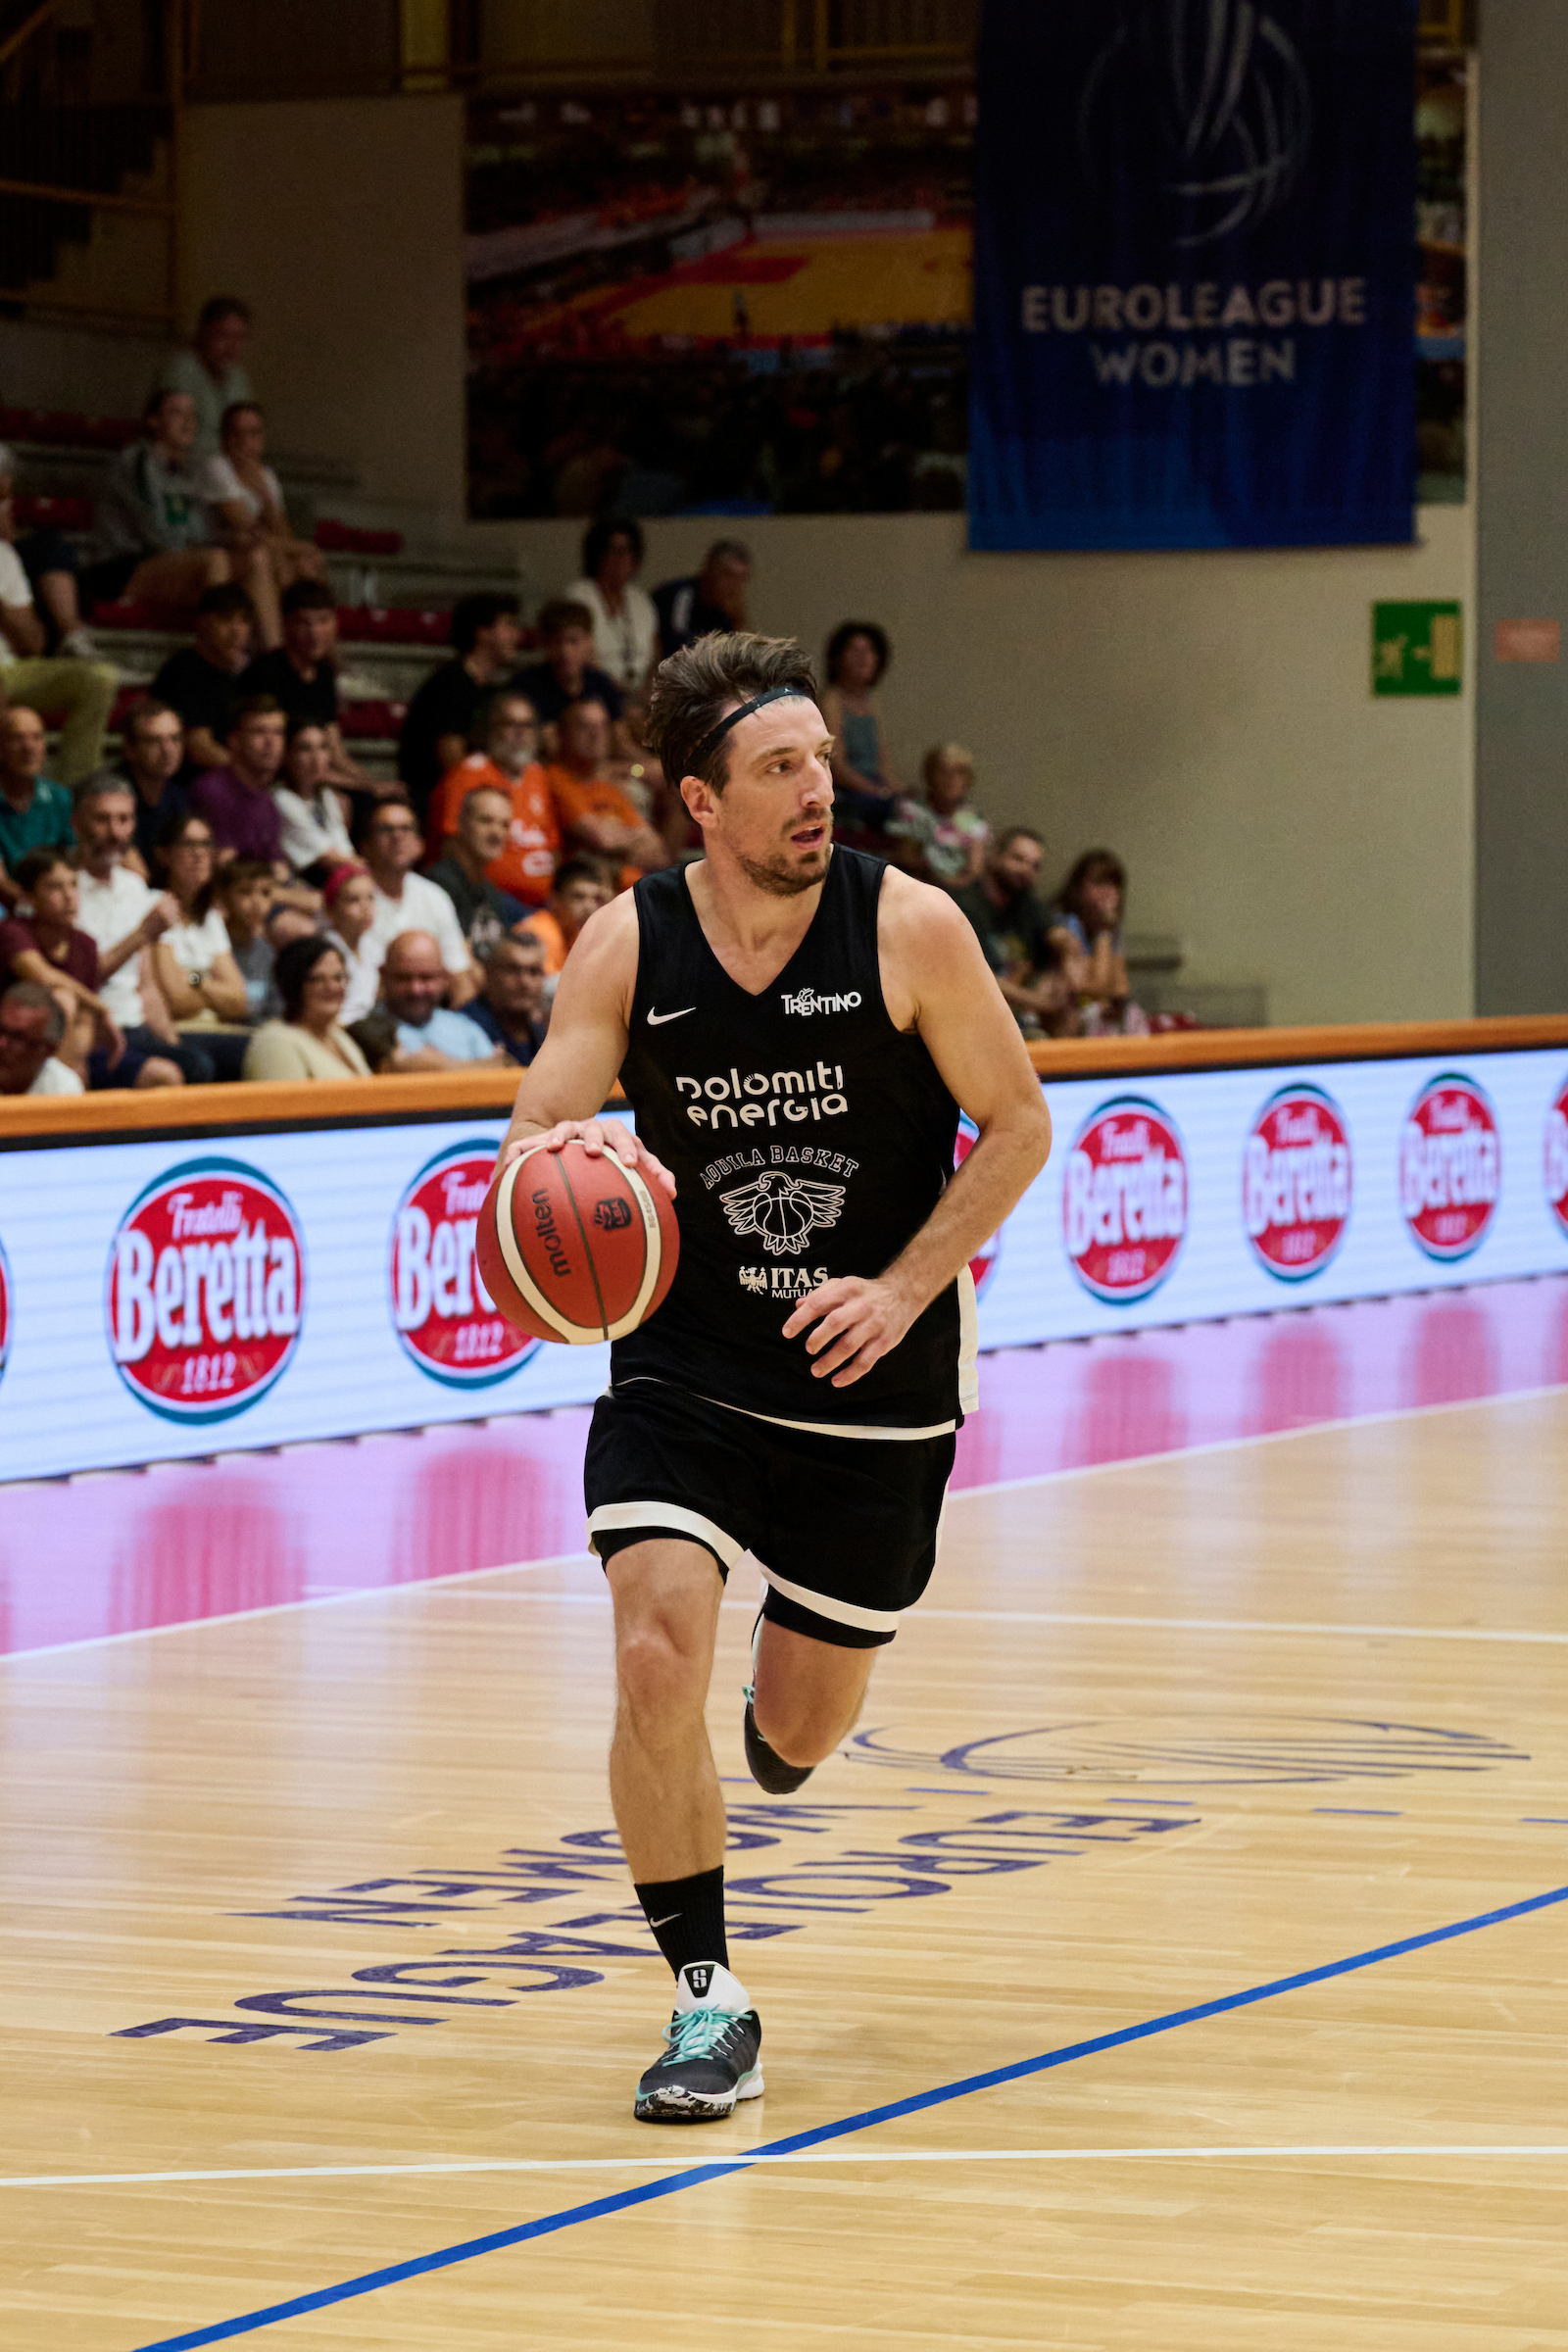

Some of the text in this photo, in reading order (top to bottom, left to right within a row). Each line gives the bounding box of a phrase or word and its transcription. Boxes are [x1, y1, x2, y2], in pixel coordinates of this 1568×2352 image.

[1021, 278, 1366, 331] EUROLEAGUE
[1093, 339, 1296, 386] WOMEN
[781, 991, 862, 1016] TRENTINO
[700, 1146, 859, 1190] AQUILA BASKET
[532, 1188, 571, 1277] molten
[116, 1218, 298, 1363] Beretta
[770, 1266, 829, 1289] ITAS
[180, 1351, 236, 1395] 1812
